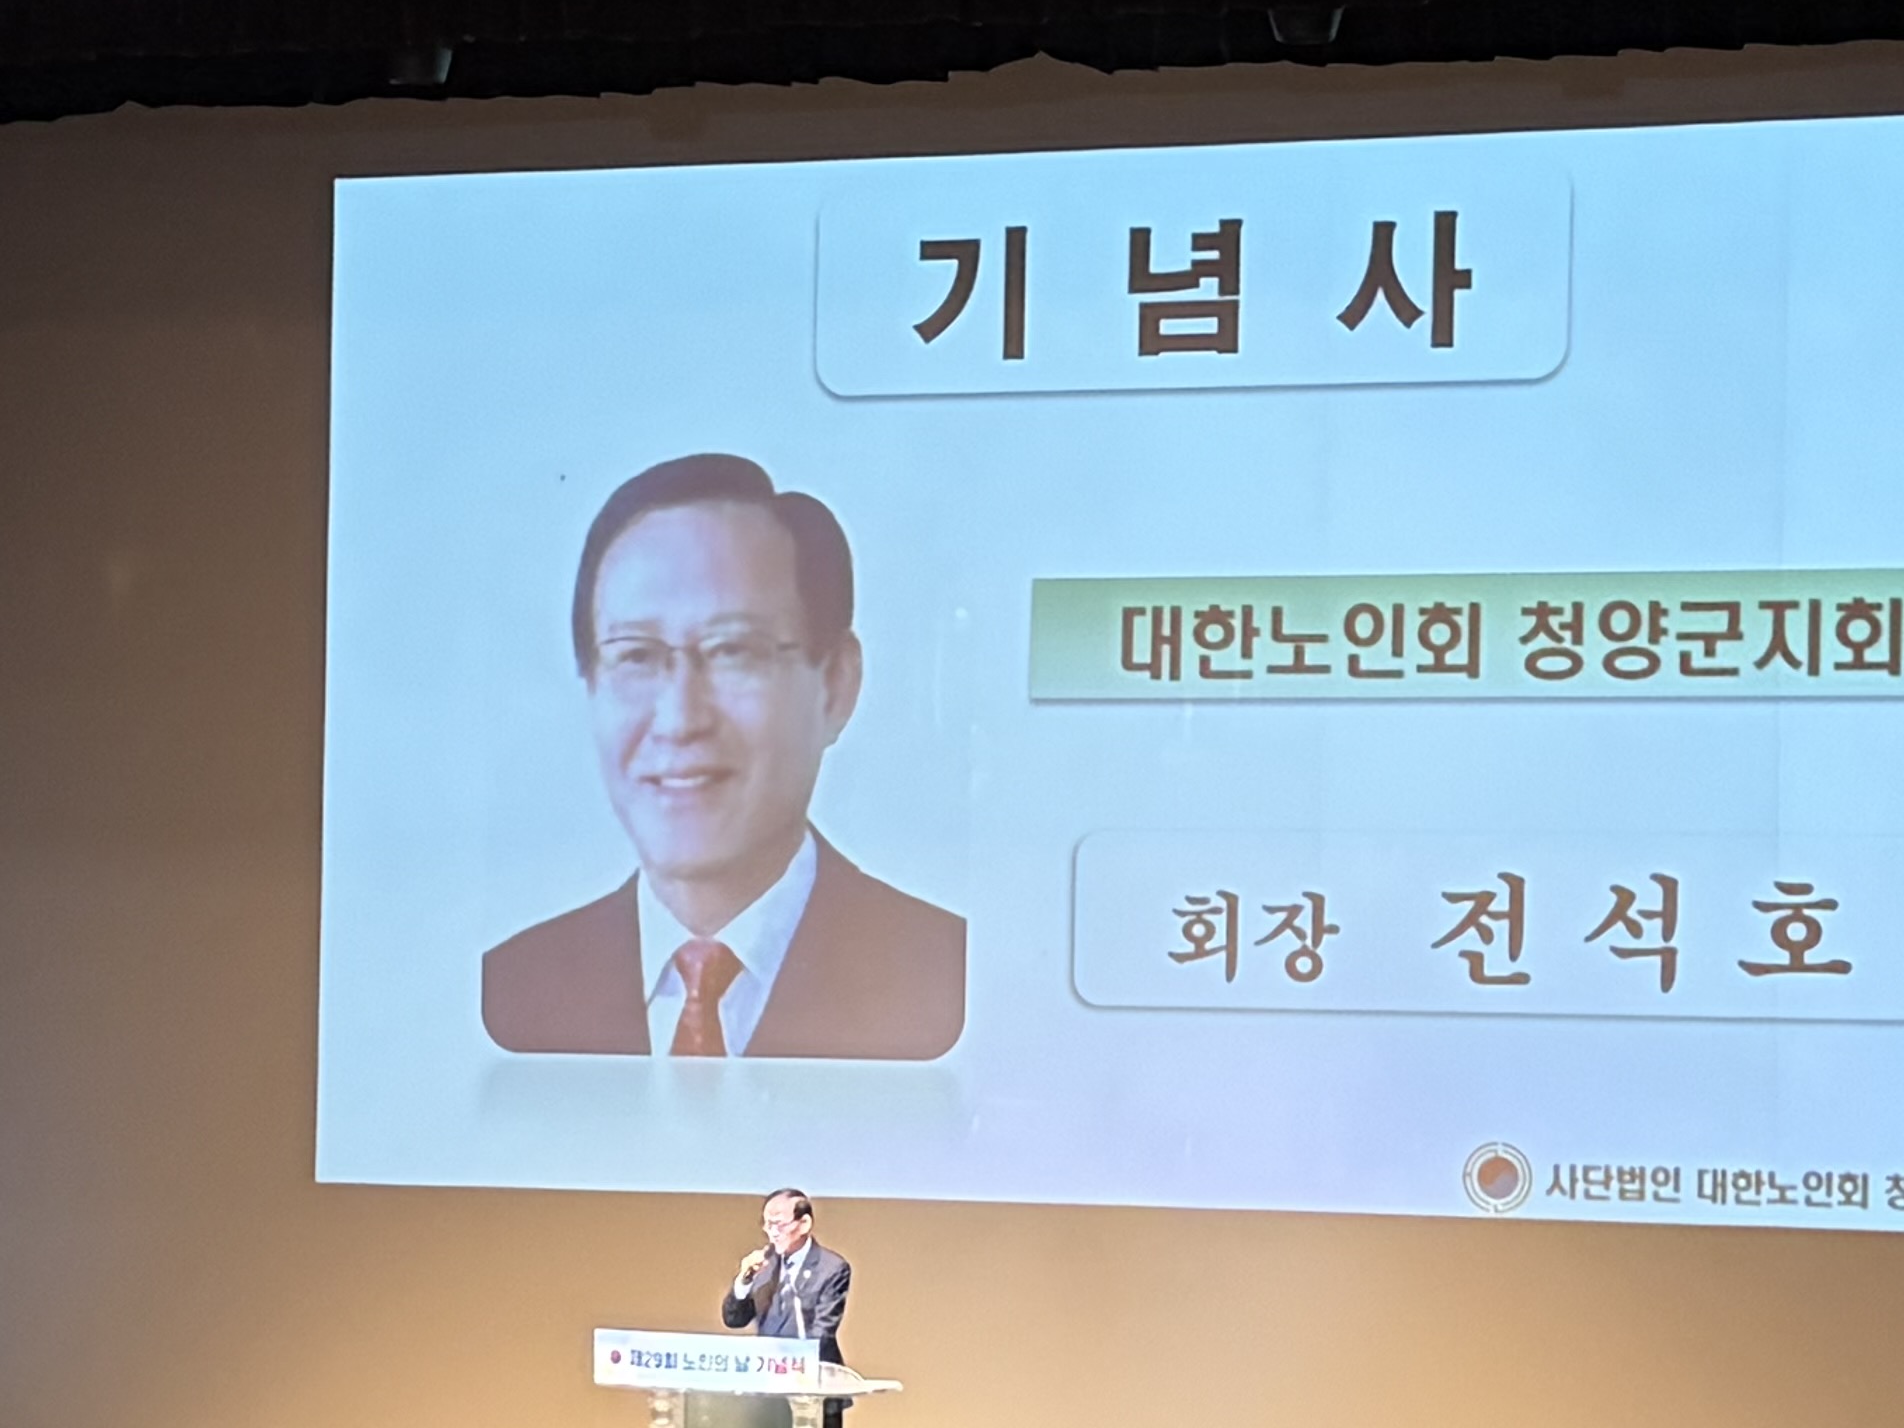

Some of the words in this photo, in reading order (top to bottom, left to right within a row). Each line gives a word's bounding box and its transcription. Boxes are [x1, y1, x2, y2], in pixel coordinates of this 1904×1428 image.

[1120, 600, 1483, 683] 대한노인회
[1517, 595, 1904, 682] 청양군지회
[1166, 888, 1341, 985] 회장
[1545, 1162, 1682, 1204] 사단법인
[1696, 1167, 1870, 1211] 대한노인회
